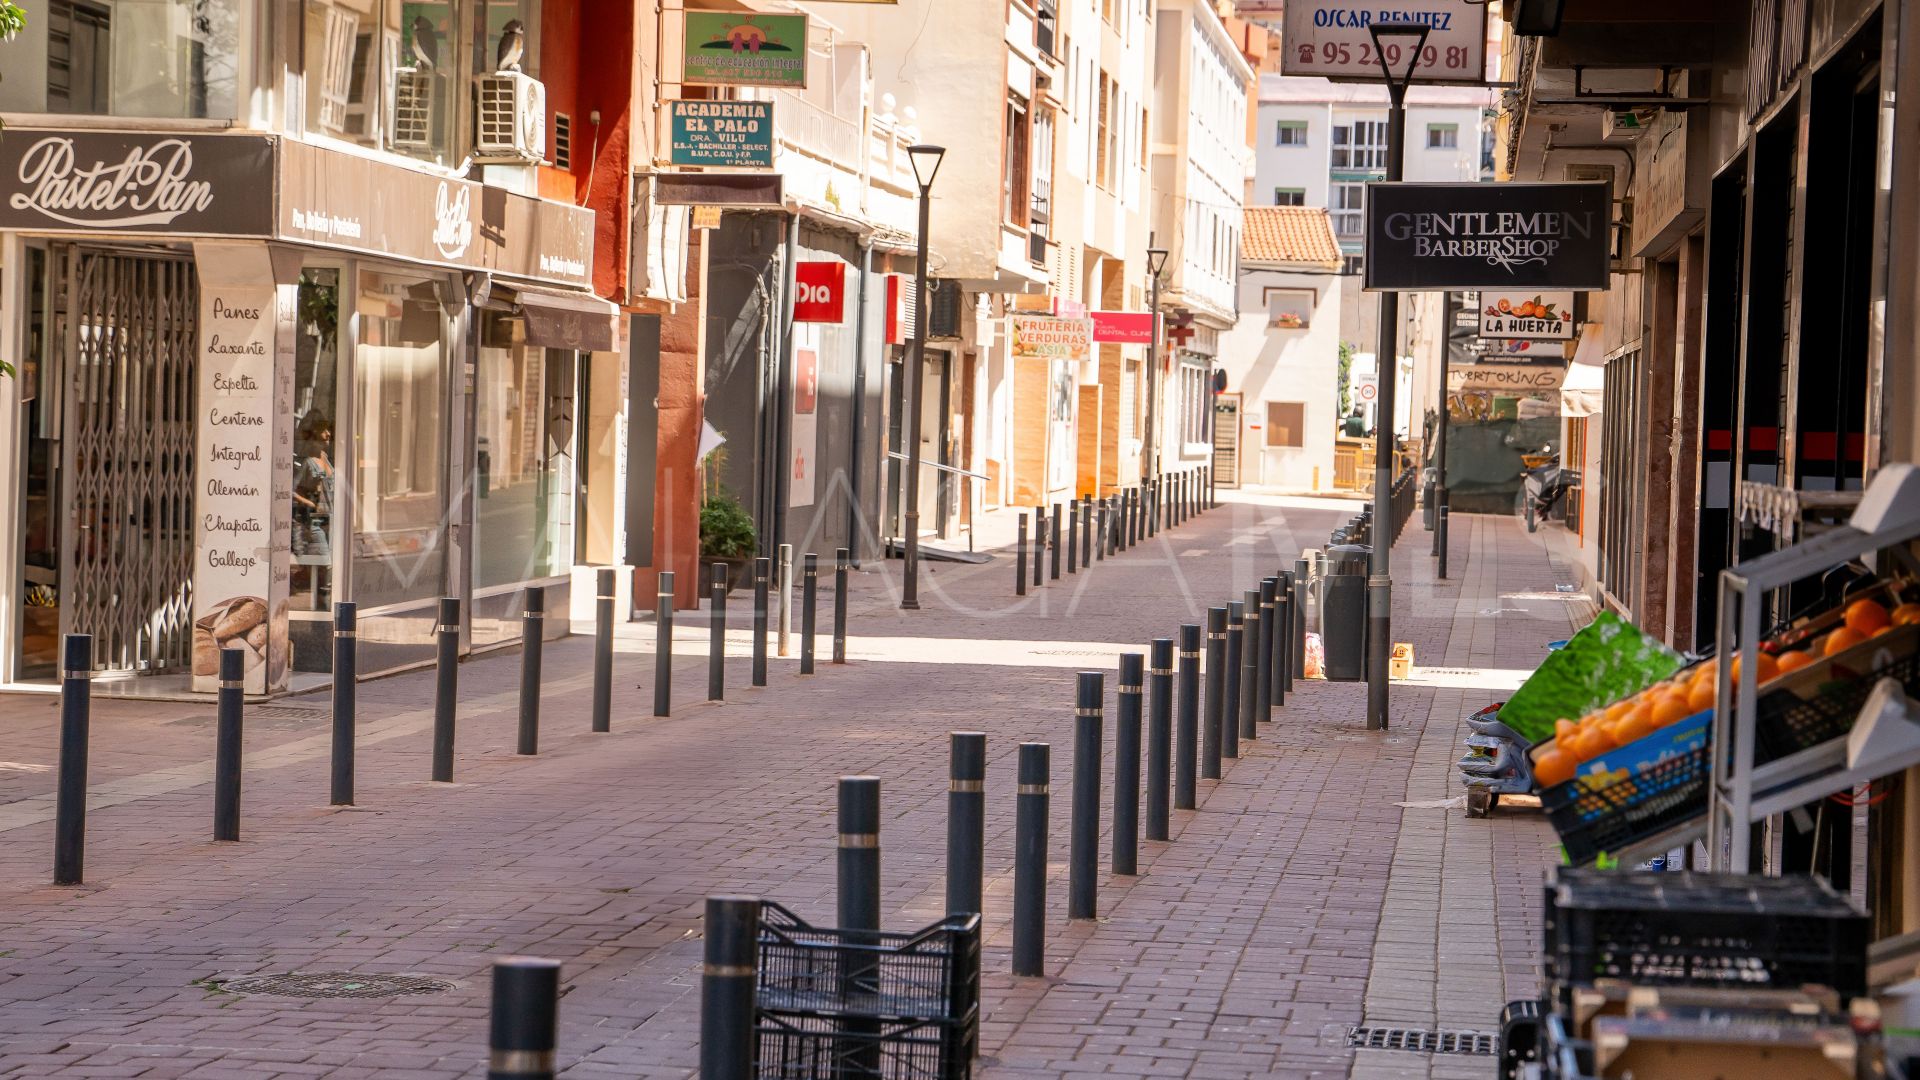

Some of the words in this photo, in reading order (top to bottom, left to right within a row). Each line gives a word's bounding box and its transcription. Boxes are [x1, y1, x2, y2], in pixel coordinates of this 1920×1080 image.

[1314, 9, 1371, 28] OSCAR
[1323, 42, 1350, 64] 95
[1358, 43, 1401, 66] 229
[1445, 46, 1468, 69] 81
[675, 103, 766, 118] ACADEMIA
[686, 119, 708, 132] EL
[714, 119, 759, 133] PALO
[698, 143, 737, 151] BACHILLER
[719, 133, 746, 143] VILU
[1384, 211, 1595, 241] GENTLEMEN
[213, 297, 260, 319] Panes
[1486, 319, 1503, 332] LA
[1509, 320, 1562, 334] HUERTA
[208, 334, 266, 355] Laxante
[1019, 332, 1087, 344] VERDURAS
[1037, 344, 1067, 355] ASIA
[213, 372, 259, 395] Espelta
[210, 407, 265, 426] Centeno
[210, 444, 262, 470] Integral
[207, 479, 260, 496] Alemán
[205, 513, 263, 537] Chapata
[208, 549, 257, 576] Gallego
